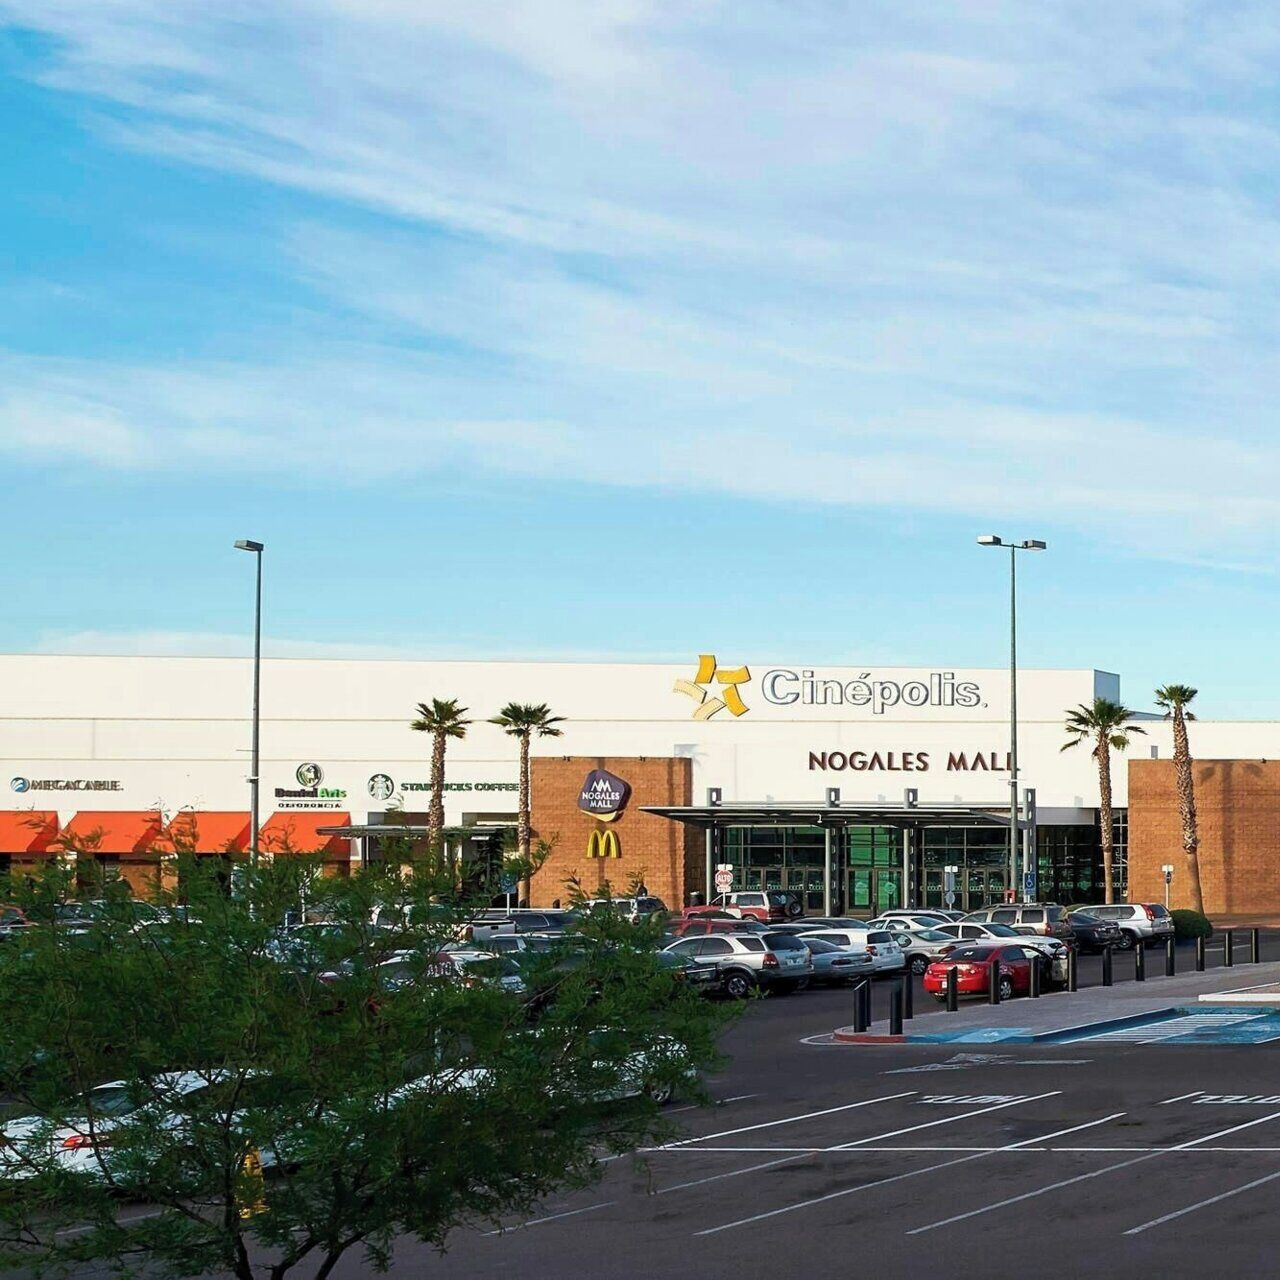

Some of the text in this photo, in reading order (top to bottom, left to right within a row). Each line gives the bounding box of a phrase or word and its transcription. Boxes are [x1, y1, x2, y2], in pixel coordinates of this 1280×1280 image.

[809, 751, 930, 771] NOGALES
[401, 782, 519, 792] STARUCKS COFFEE
[318, 787, 347, 798] Arts
[582, 791, 620, 800] NOGALES
[589, 800, 612, 808] MALL
